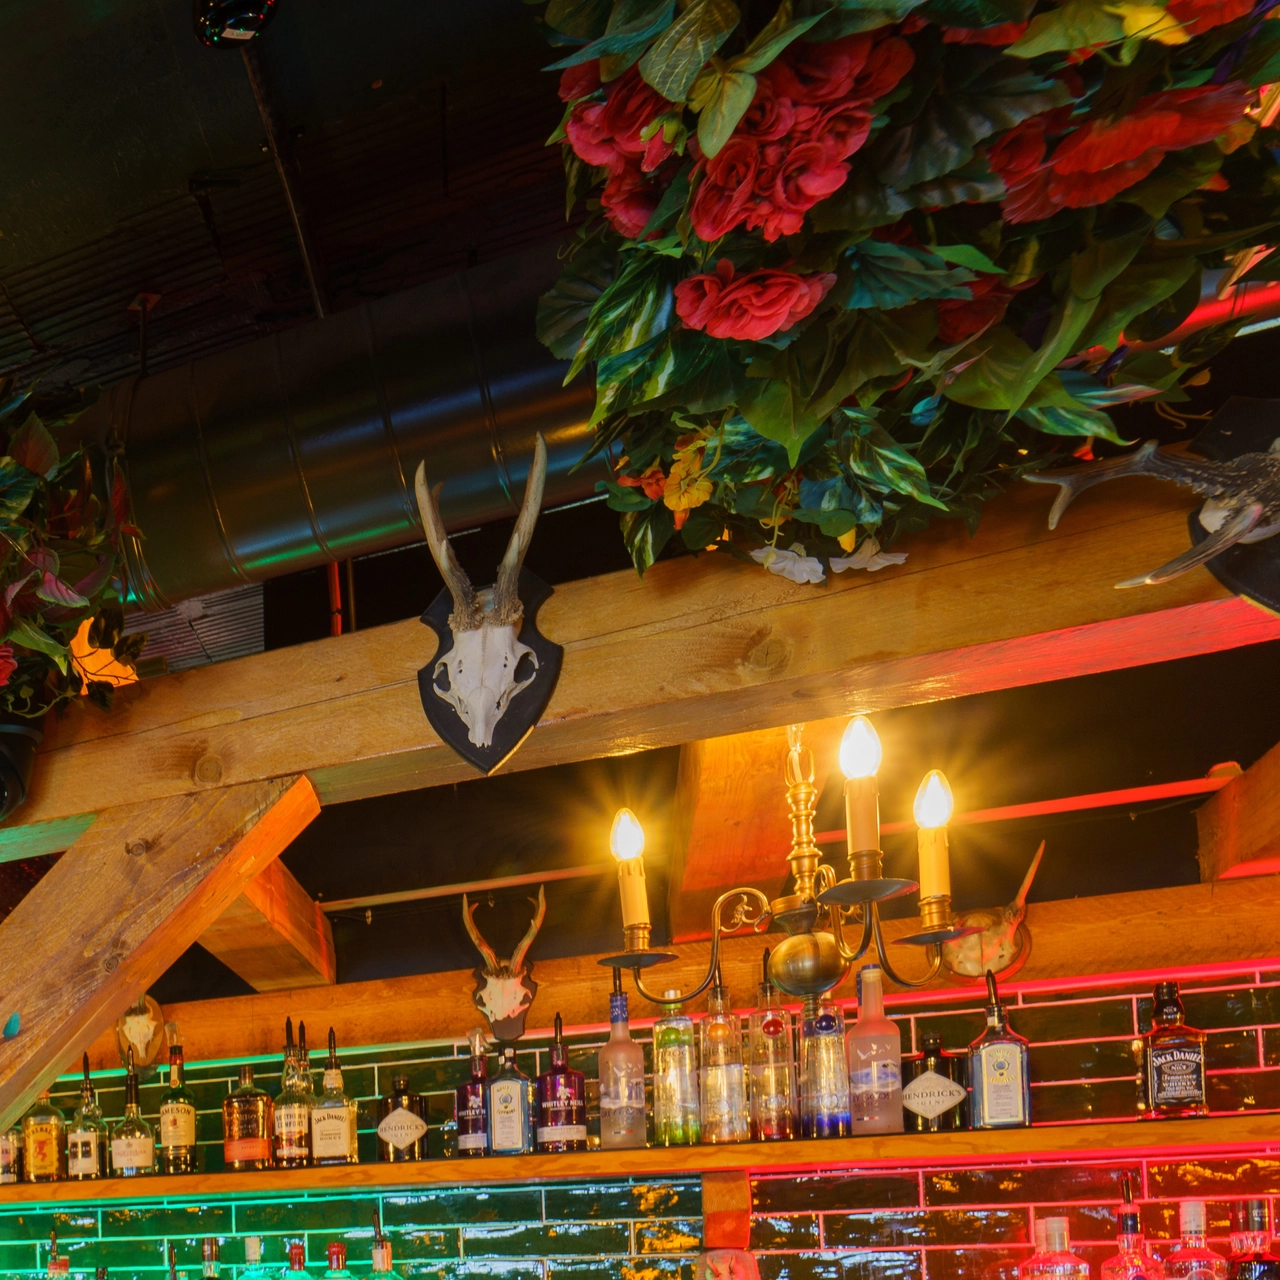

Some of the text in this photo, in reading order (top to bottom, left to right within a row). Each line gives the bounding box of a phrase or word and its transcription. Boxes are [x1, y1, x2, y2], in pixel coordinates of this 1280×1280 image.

[1153, 1050, 1202, 1067] JACK DANIEL
[902, 1089, 962, 1101] HENDRICK'S
[542, 1100, 569, 1109] WHITLEY
[161, 1107, 192, 1117] AMESON
[314, 1115, 327, 1126] JACK
[380, 1123, 426, 1134] HENDRICK'S
